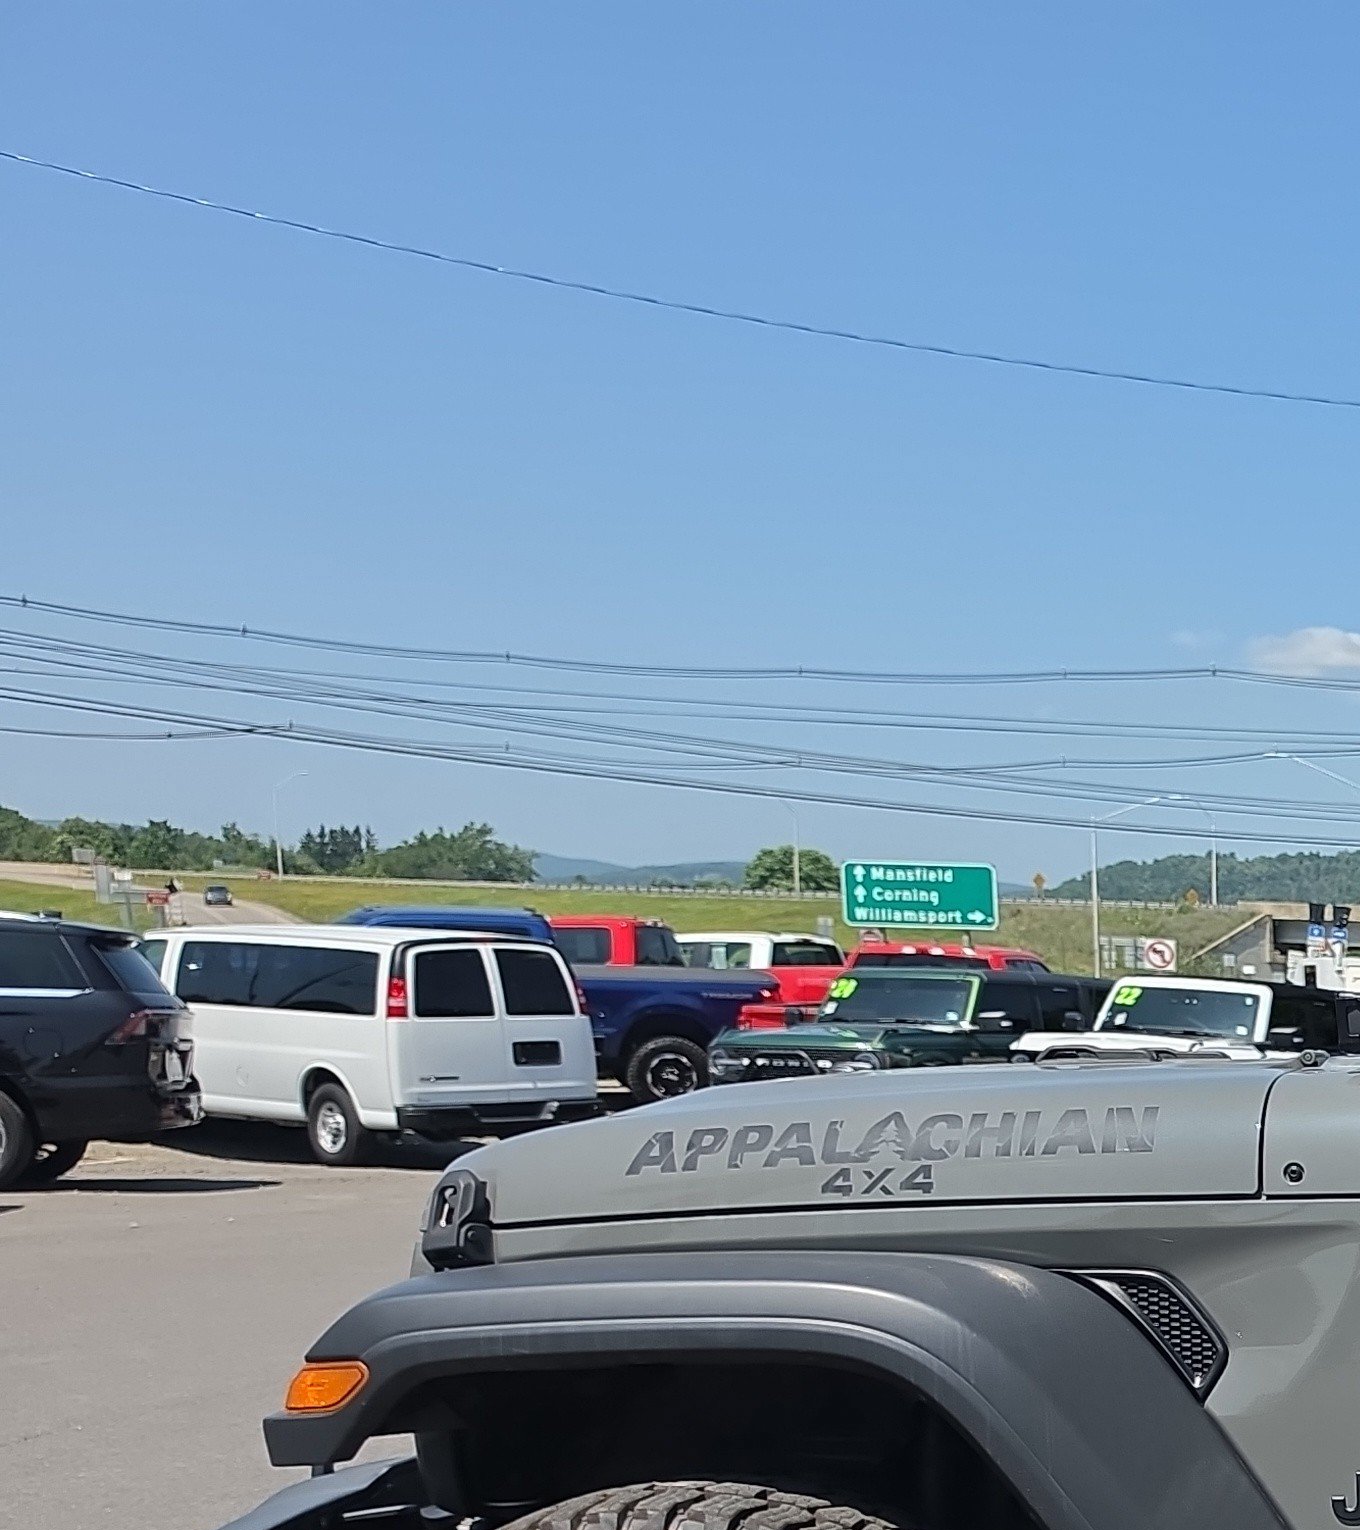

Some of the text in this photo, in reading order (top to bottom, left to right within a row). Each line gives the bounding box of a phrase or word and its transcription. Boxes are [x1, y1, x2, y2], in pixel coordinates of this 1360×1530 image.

[870, 866, 953, 883] Mansfield
[872, 886, 939, 906] Corning
[854, 907, 962, 924] Williamsport
[1114, 986, 1143, 1006] 22
[624, 1106, 1161, 1176] APPALACHIAN
